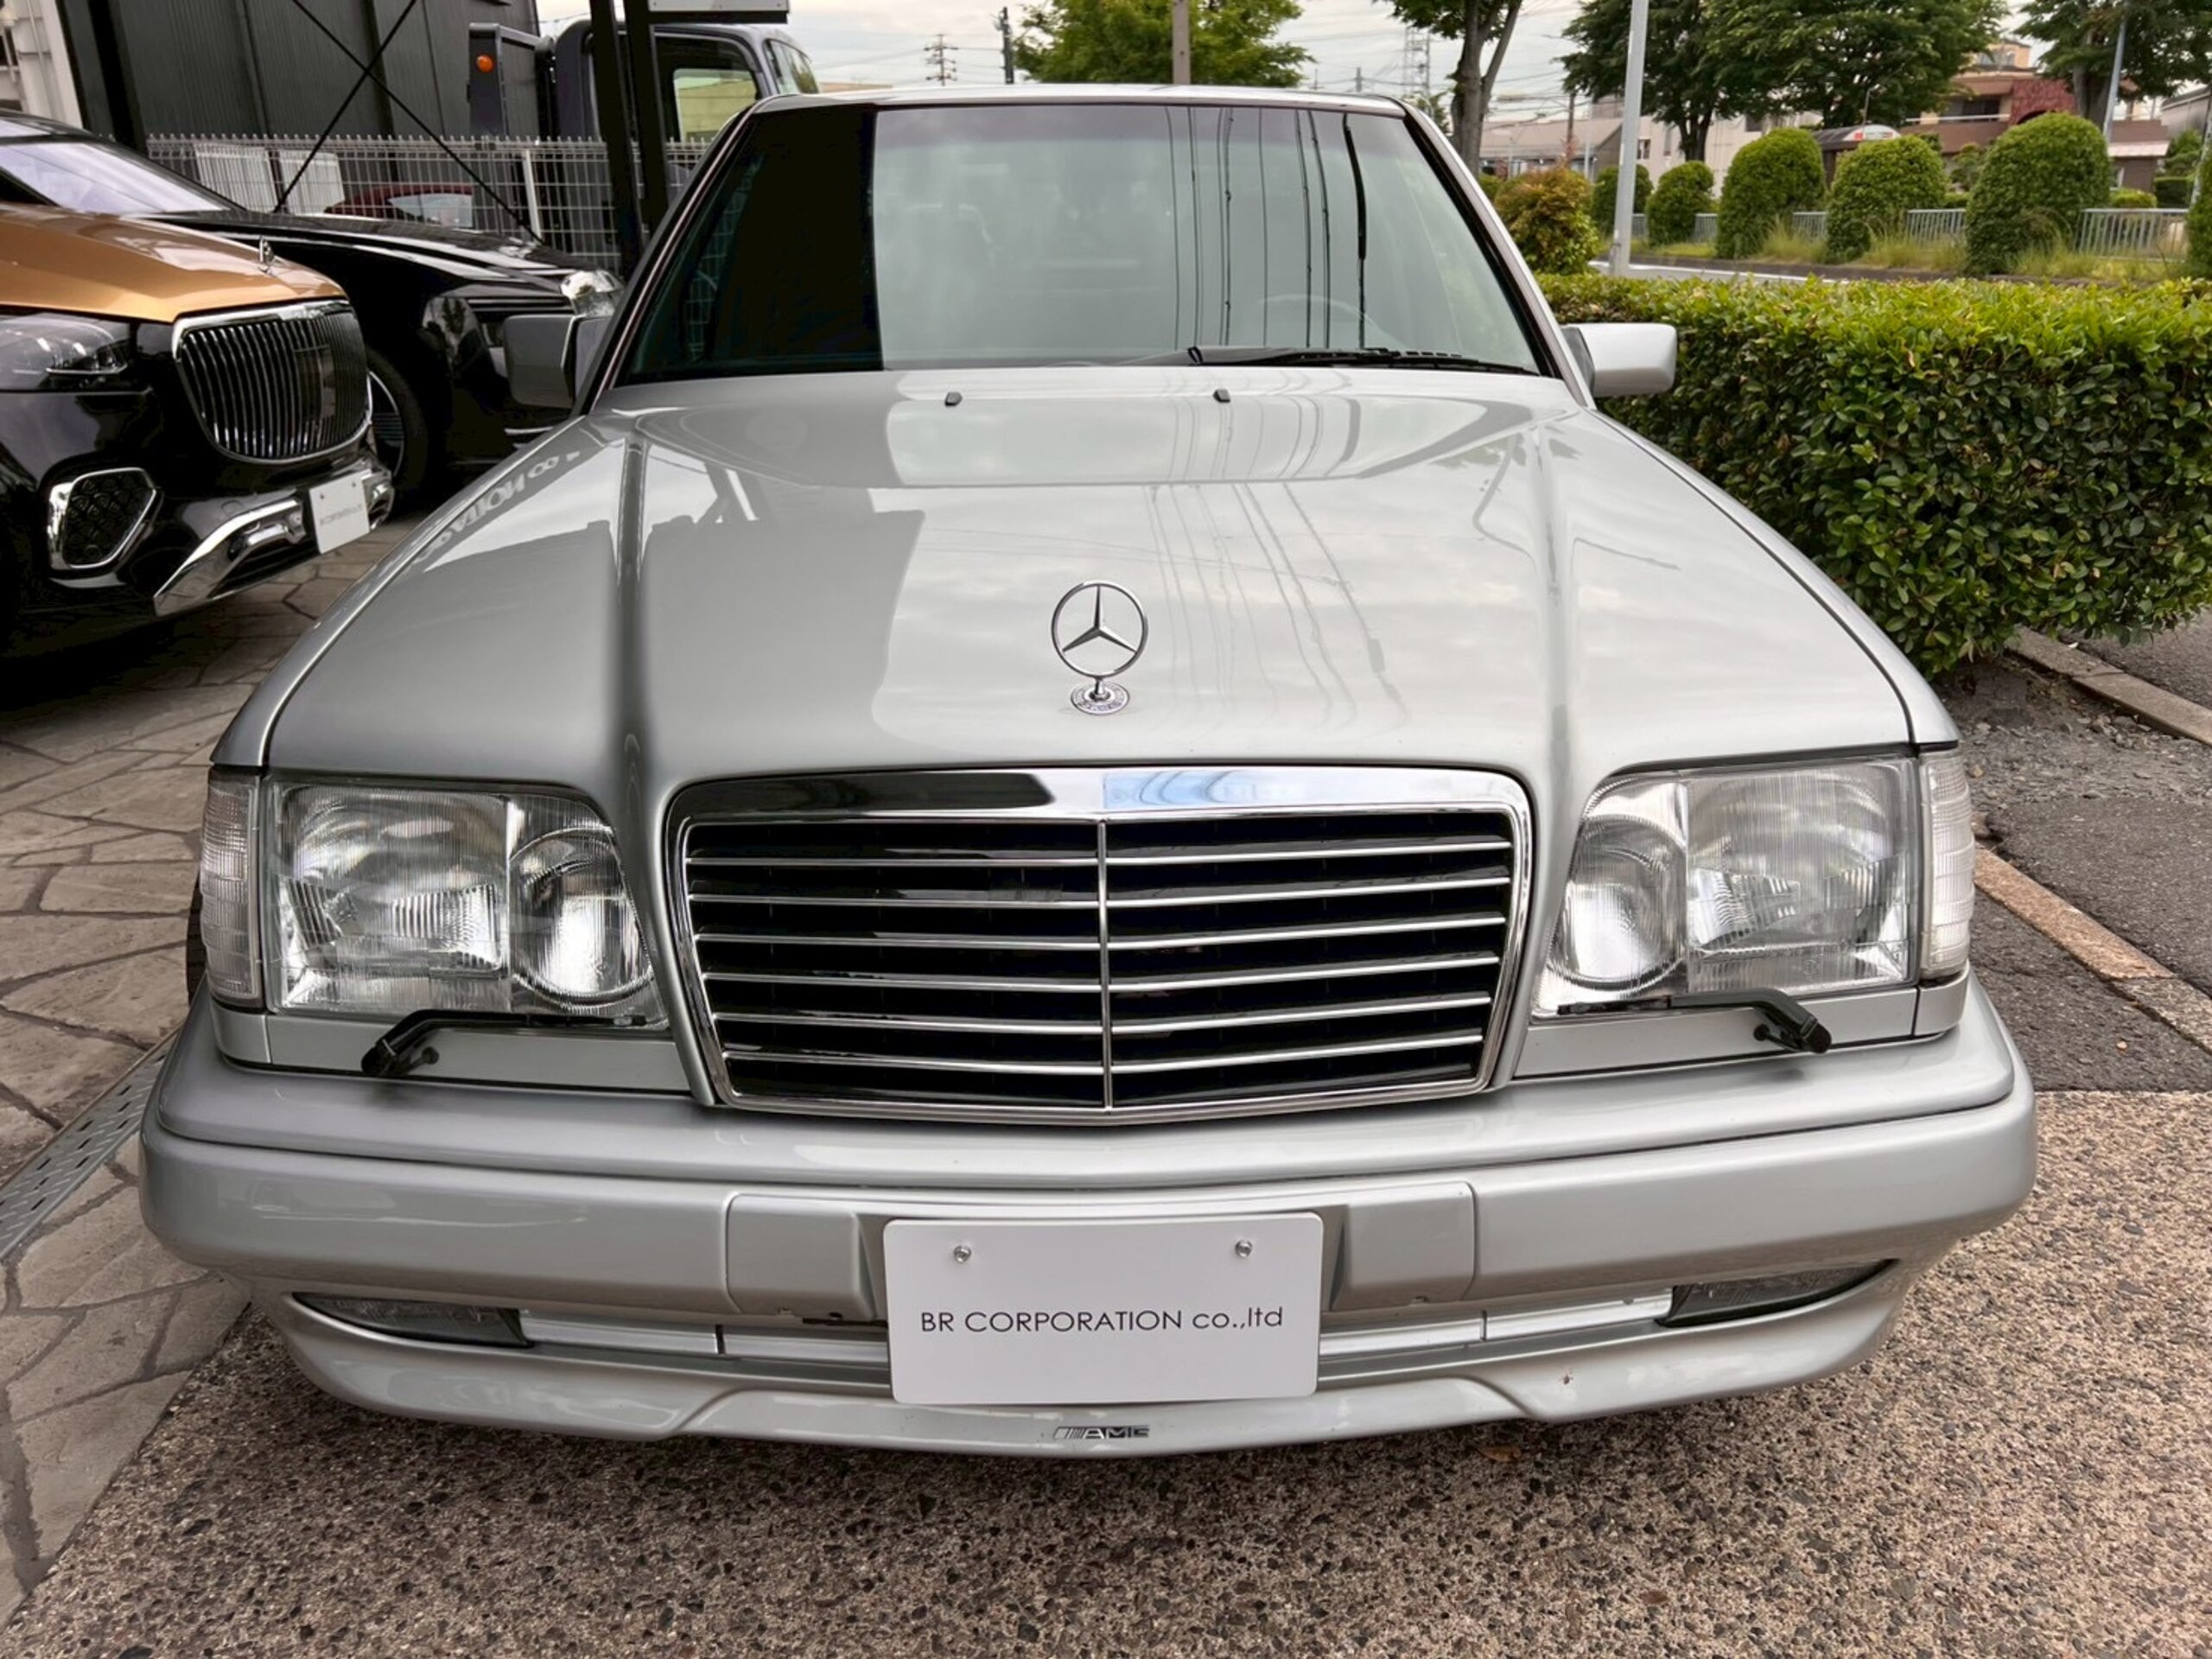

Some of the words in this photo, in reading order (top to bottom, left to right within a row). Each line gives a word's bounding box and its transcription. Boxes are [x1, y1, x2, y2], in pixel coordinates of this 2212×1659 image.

[921, 1312, 955, 1332] BR
[964, 1310, 1182, 1332] CORPORATION
[1192, 1306, 1283, 1330] co.,ltd
